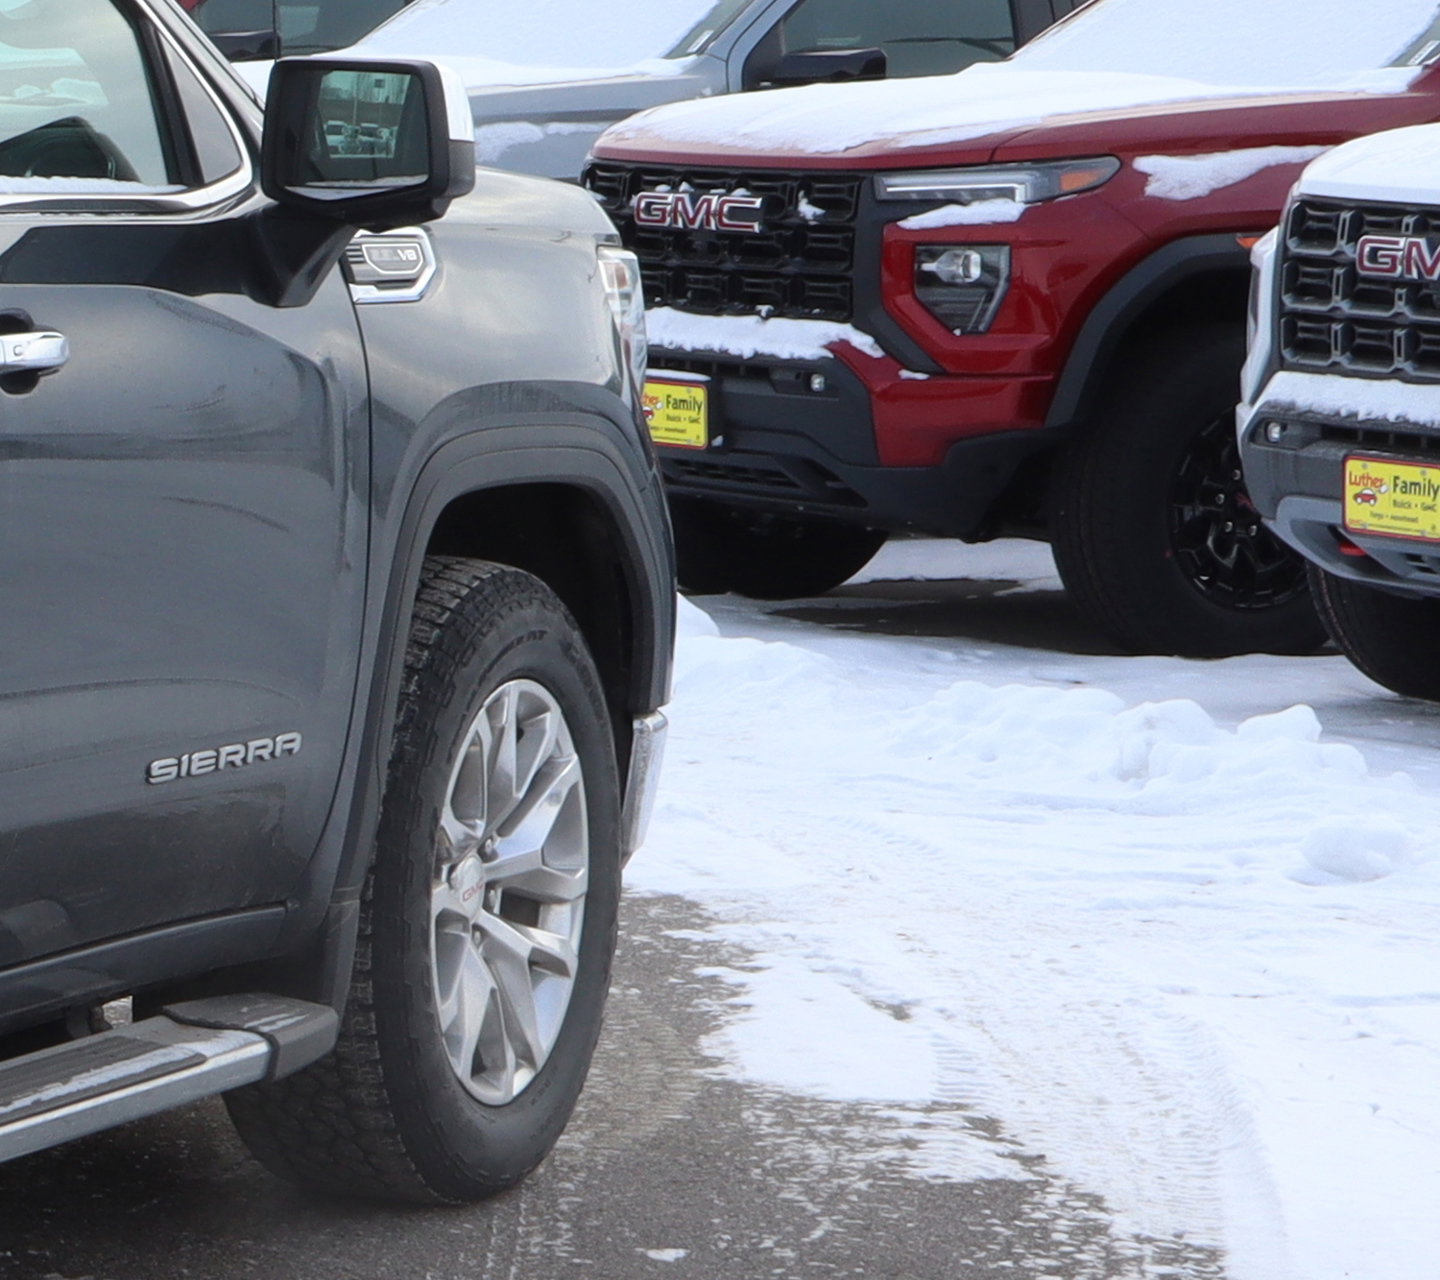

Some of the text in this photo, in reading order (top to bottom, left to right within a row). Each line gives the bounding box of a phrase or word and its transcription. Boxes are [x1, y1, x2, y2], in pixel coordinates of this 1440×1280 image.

[634, 191, 762, 233] GMC
[397, 249, 417, 261] V8
[1355, 234, 1440, 281] GM
[665, 393, 703, 416] Family
[1348, 471, 1440, 502] Luther Family
[147, 731, 303, 785] SIERRA
